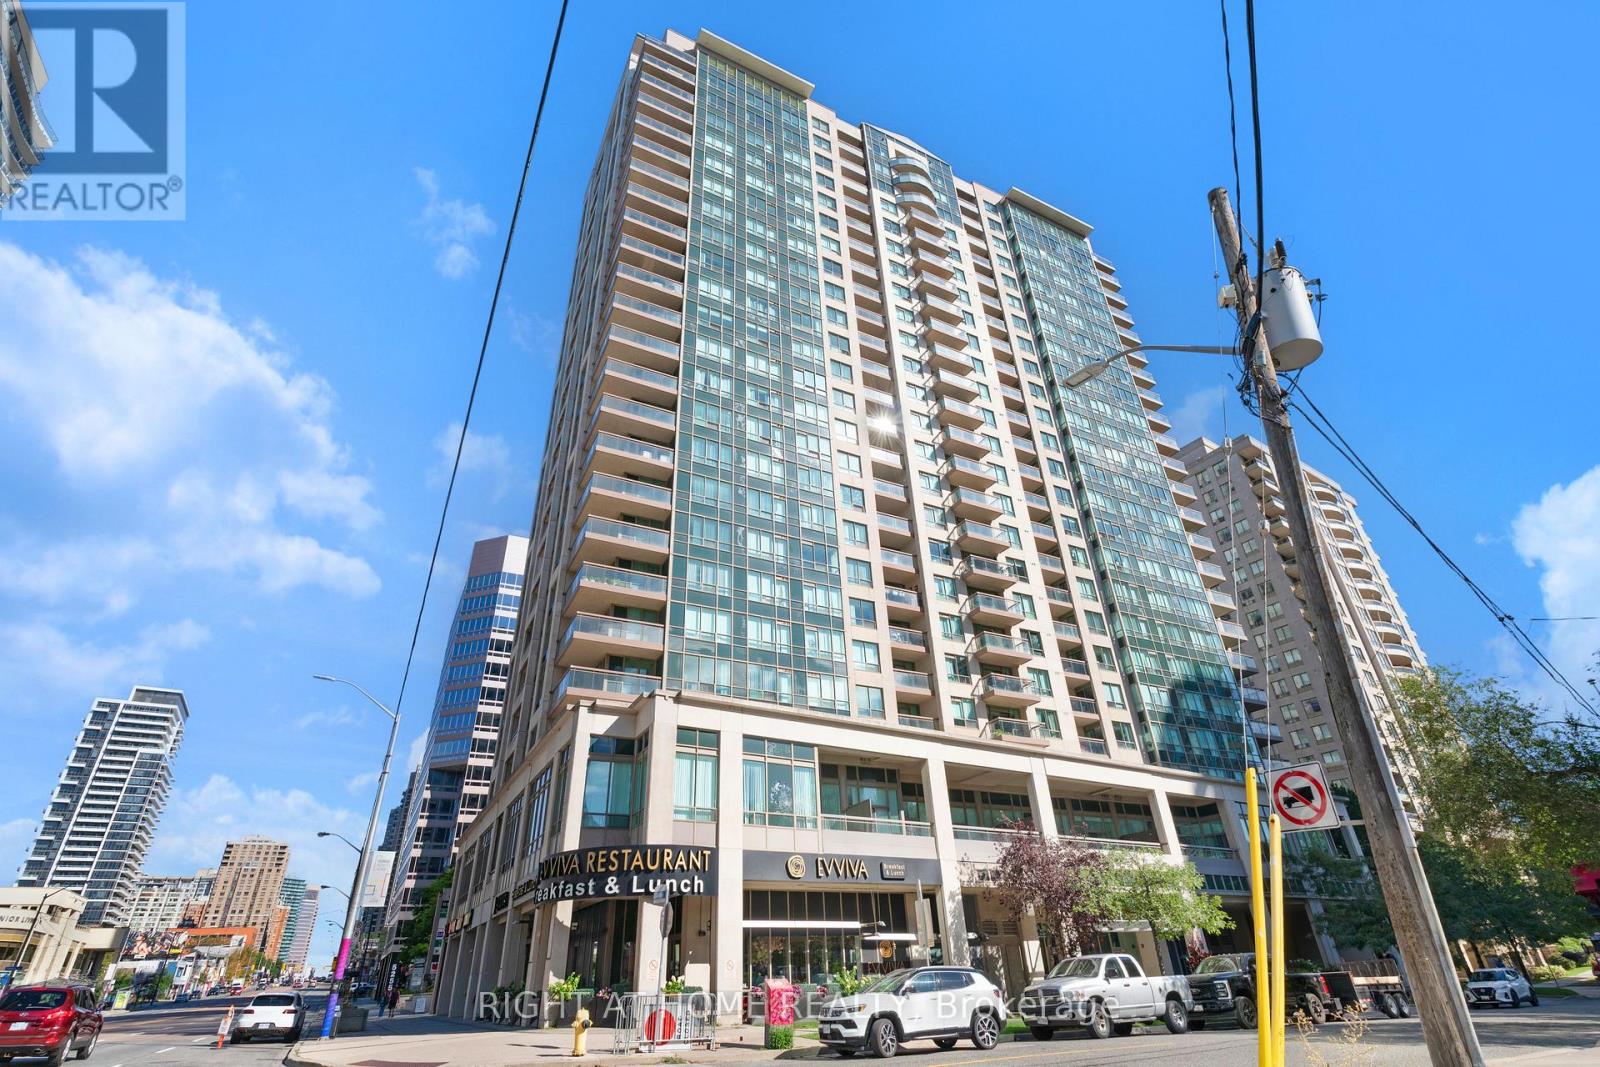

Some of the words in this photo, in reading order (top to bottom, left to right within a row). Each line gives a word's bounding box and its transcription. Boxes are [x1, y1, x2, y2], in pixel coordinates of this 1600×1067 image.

[540, 853, 580, 881] VVIVA
[586, 848, 711, 873] RESTAURANT
[816, 857, 869, 879] EVVIVA
[535, 877, 596, 903] reakfast
[604, 876, 620, 894] &
[632, 875, 704, 893] Lunch
